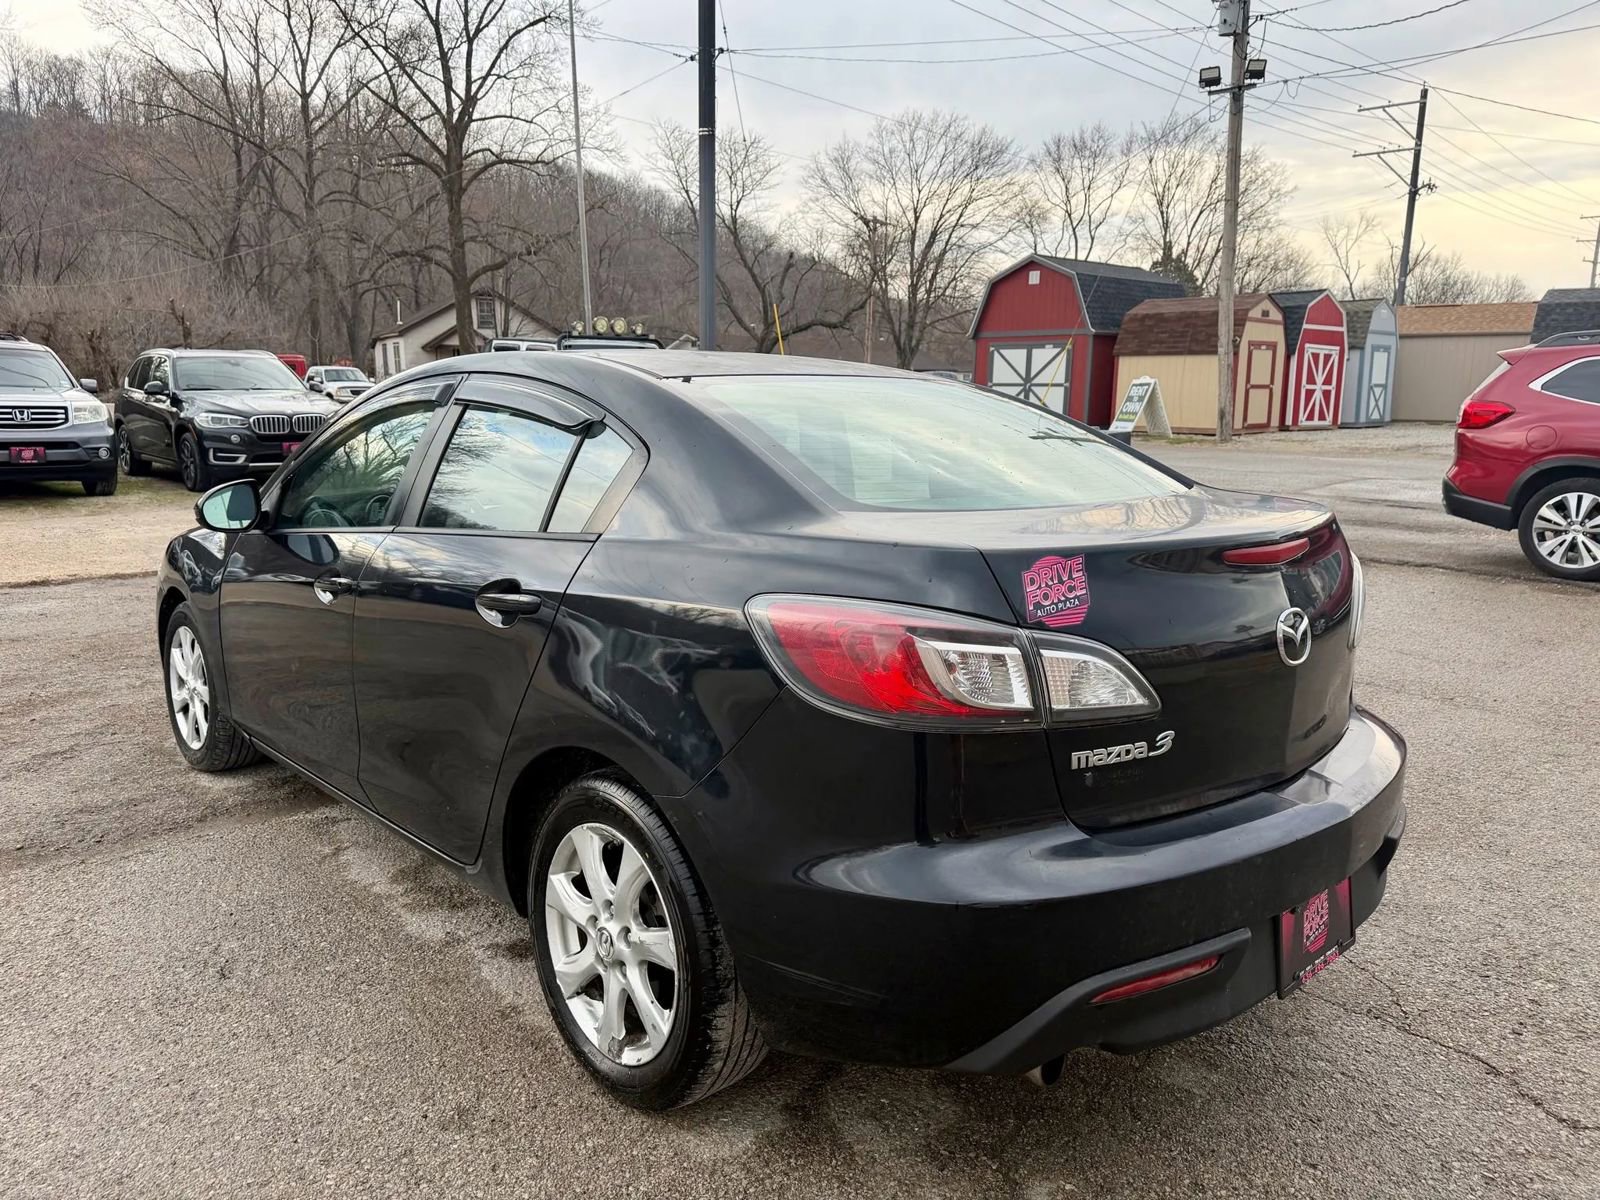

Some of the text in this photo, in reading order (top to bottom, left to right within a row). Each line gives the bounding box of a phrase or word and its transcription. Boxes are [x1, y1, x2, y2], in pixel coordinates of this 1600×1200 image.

[1129, 385, 1149, 397] RENT
[1122, 401, 1142, 413] OWN
[1023, 557, 1083, 593] DRIVE
[1026, 576, 1087, 610] FORCE
[1036, 598, 1080, 617] AUTO PLAZA
